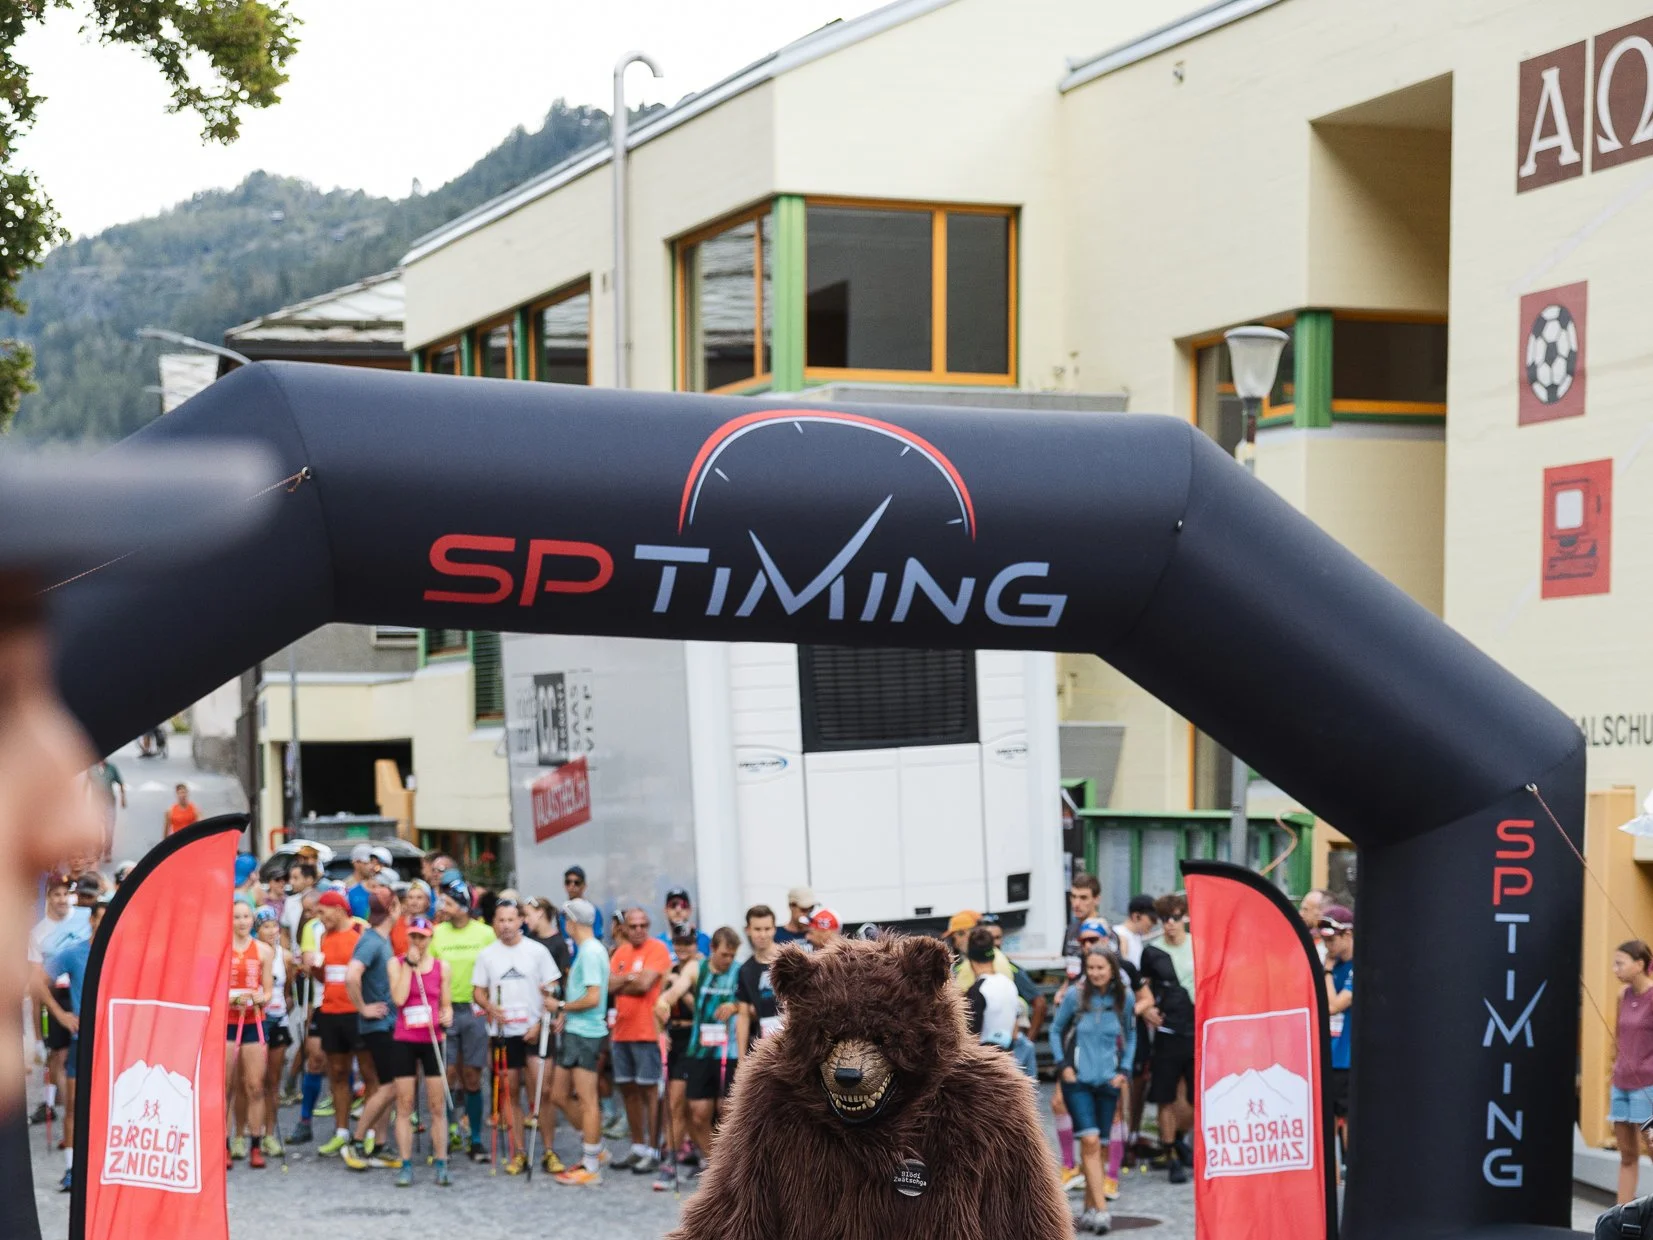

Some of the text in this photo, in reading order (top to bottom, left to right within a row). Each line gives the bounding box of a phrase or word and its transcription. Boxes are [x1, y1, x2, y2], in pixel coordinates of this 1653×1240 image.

[424, 494, 1067, 627] SP TIMING
[1482, 820, 1548, 1188] SP TIMING
